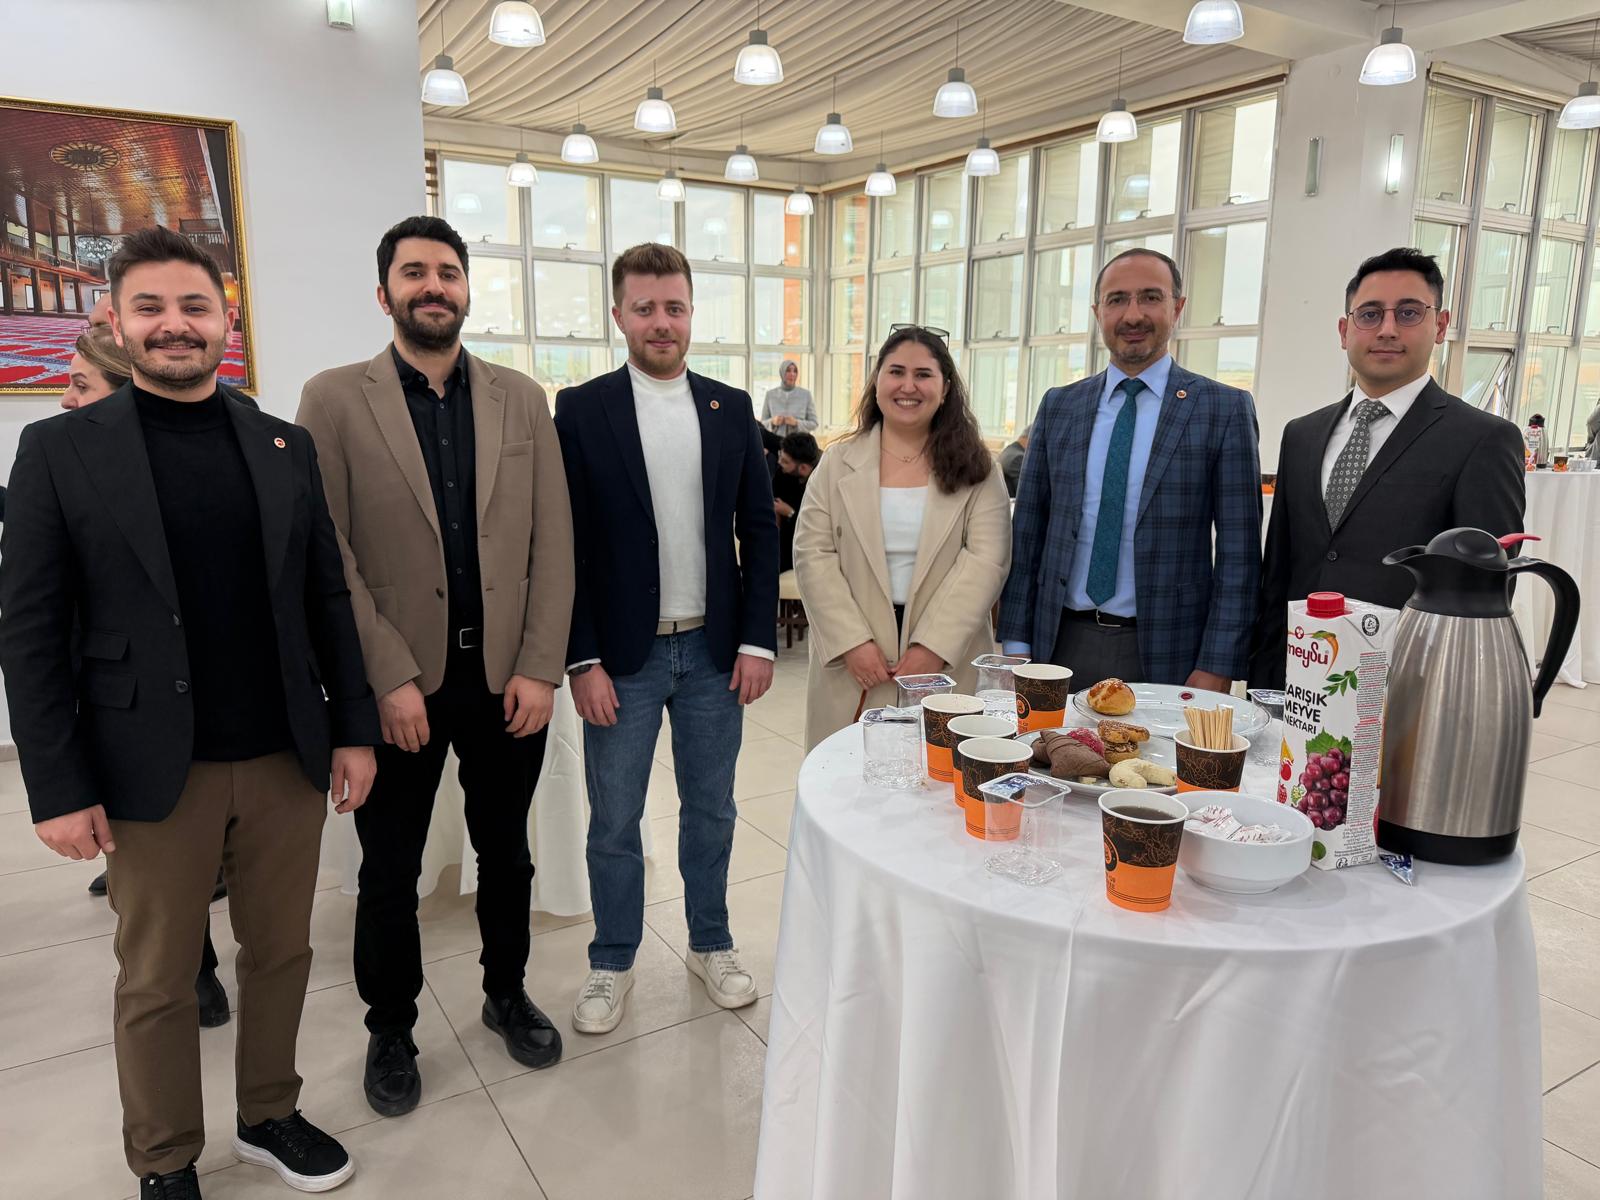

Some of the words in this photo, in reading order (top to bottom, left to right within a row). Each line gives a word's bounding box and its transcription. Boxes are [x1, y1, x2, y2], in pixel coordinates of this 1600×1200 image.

[1286, 683, 1328, 707] ARIŞIK
[1285, 699, 1321, 723] MEYVE
[1285, 714, 1317, 734] NEKTARI
